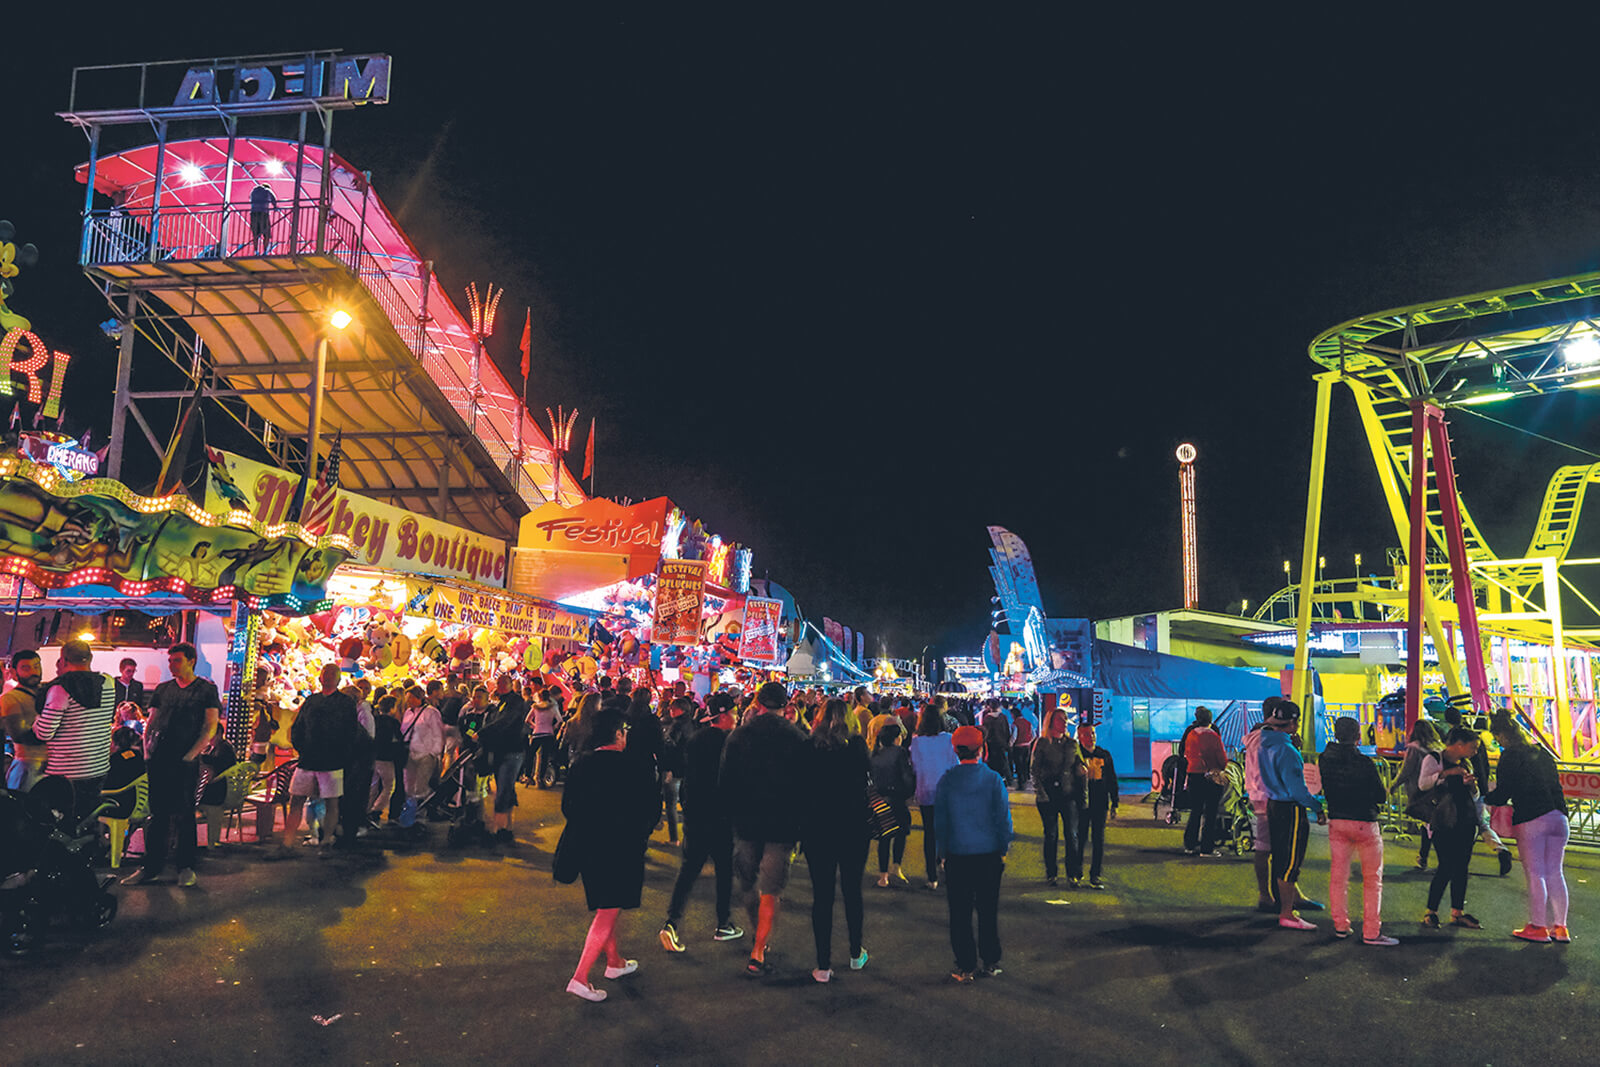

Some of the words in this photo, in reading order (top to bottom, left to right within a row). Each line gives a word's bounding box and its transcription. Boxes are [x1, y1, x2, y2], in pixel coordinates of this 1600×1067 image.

[536, 517, 660, 548] Festival
[396, 515, 505, 580] Boutique
[660, 578, 702, 591] PELUCHES
[663, 564, 703, 577] FESTIVAL
[433, 601, 455, 619] UNE
[460, 607, 495, 627] GROSSE
[500, 615, 534, 633] PELUCHE
[537, 621, 547, 634] AU
[458, 591, 474, 606] UNE
[479, 596, 501, 611] BALLE
[505, 602, 522, 615] DANS
[526, 604, 534, 618] LE
